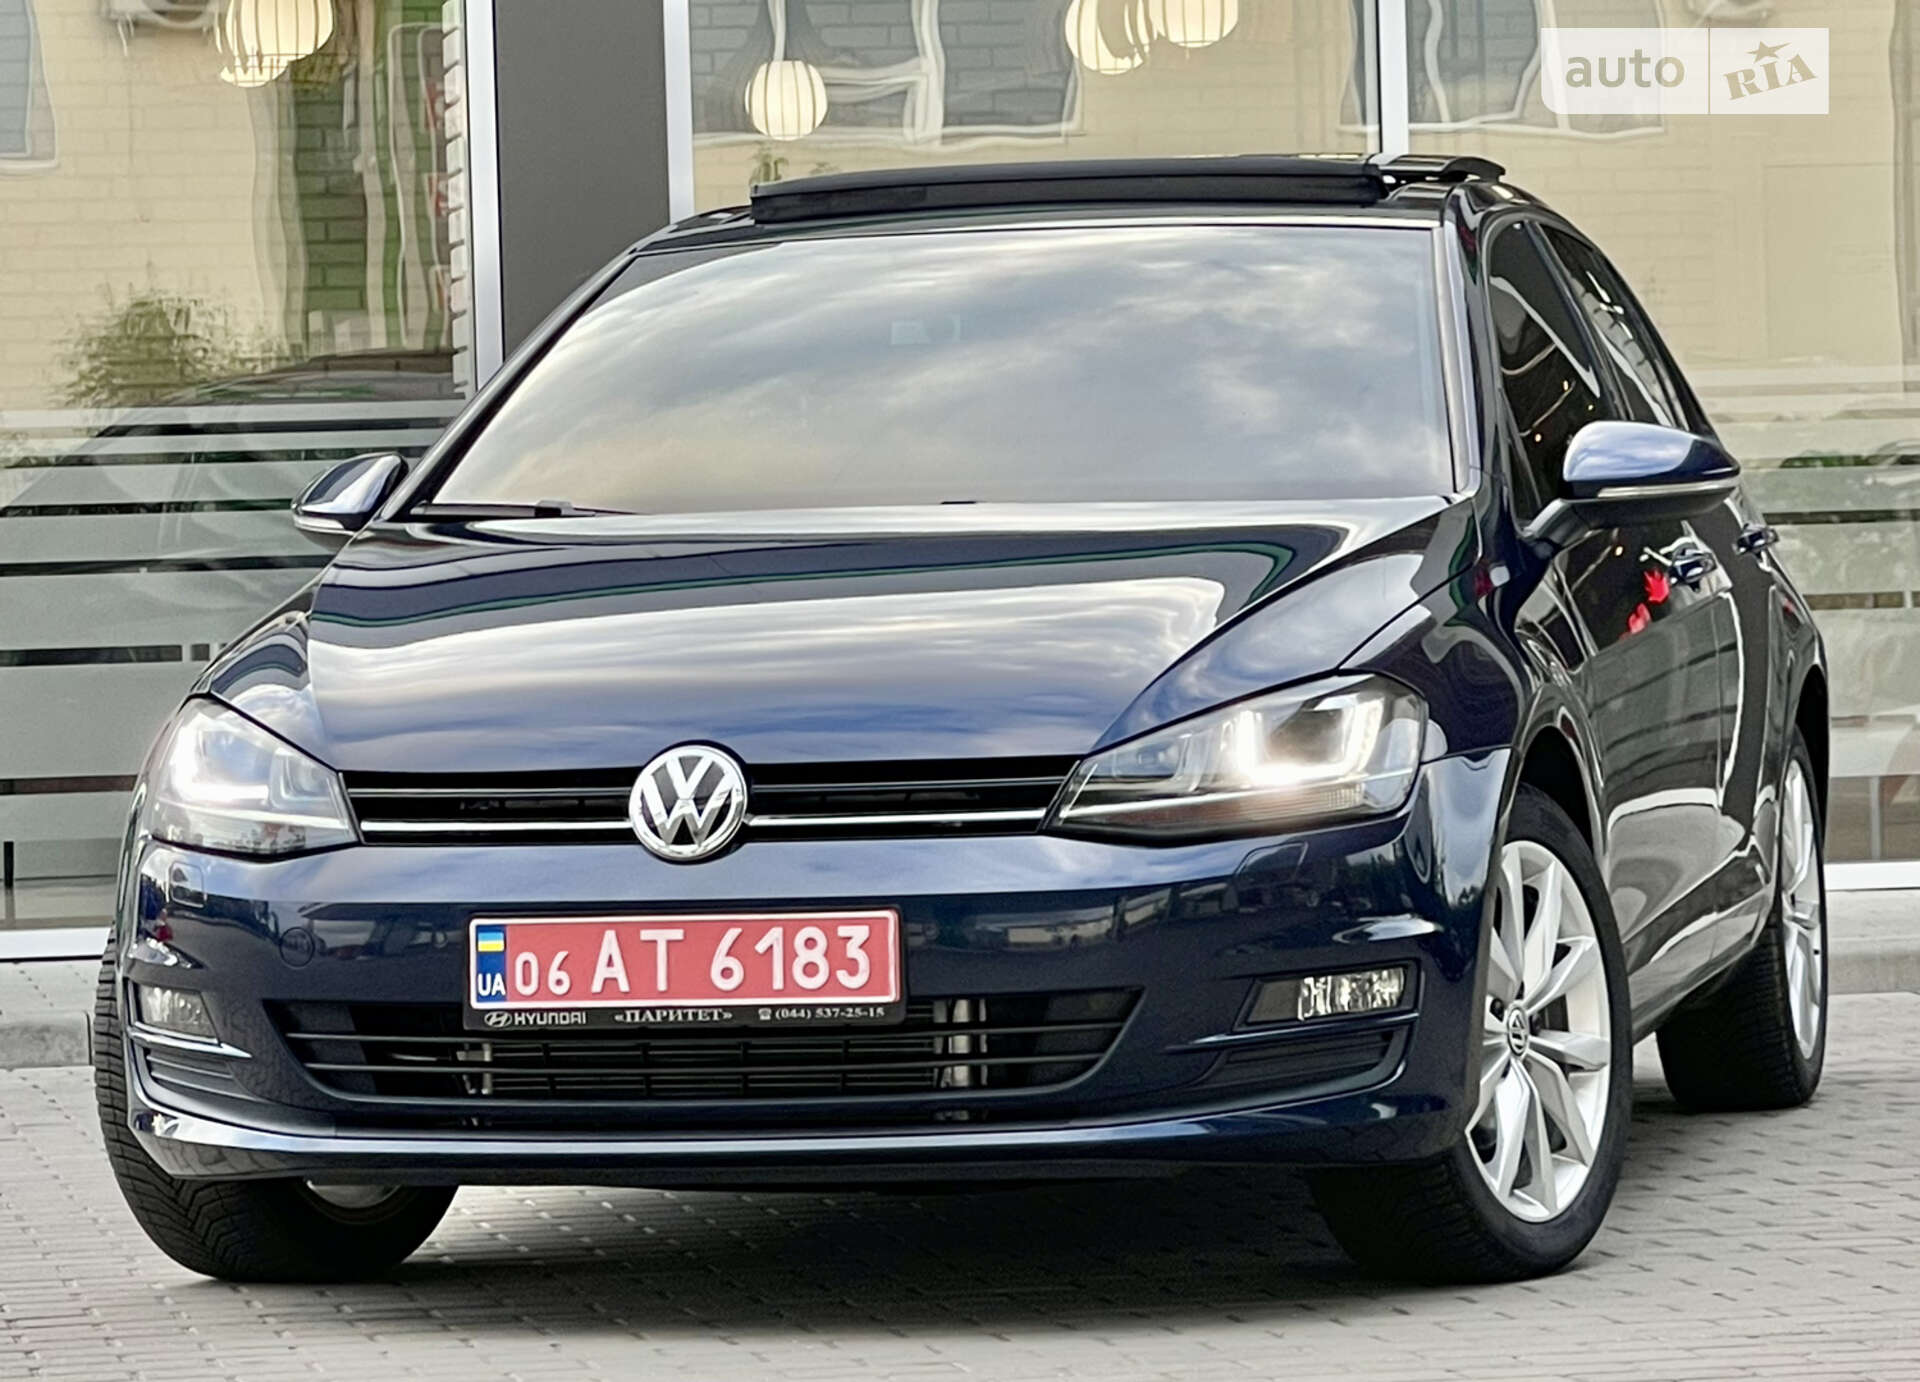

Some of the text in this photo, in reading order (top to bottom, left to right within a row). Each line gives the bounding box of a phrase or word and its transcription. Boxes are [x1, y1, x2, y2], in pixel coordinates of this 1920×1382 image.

[515, 925, 871, 996] 06 AT 6183
[477, 973, 507, 996] UA
[514, 1011, 587, 1026] HYUNDAI
[614, 1008, 733, 1024] «ПАРИТЕТ»
[775, 1007, 885, 1020] (044) 537-25-15
